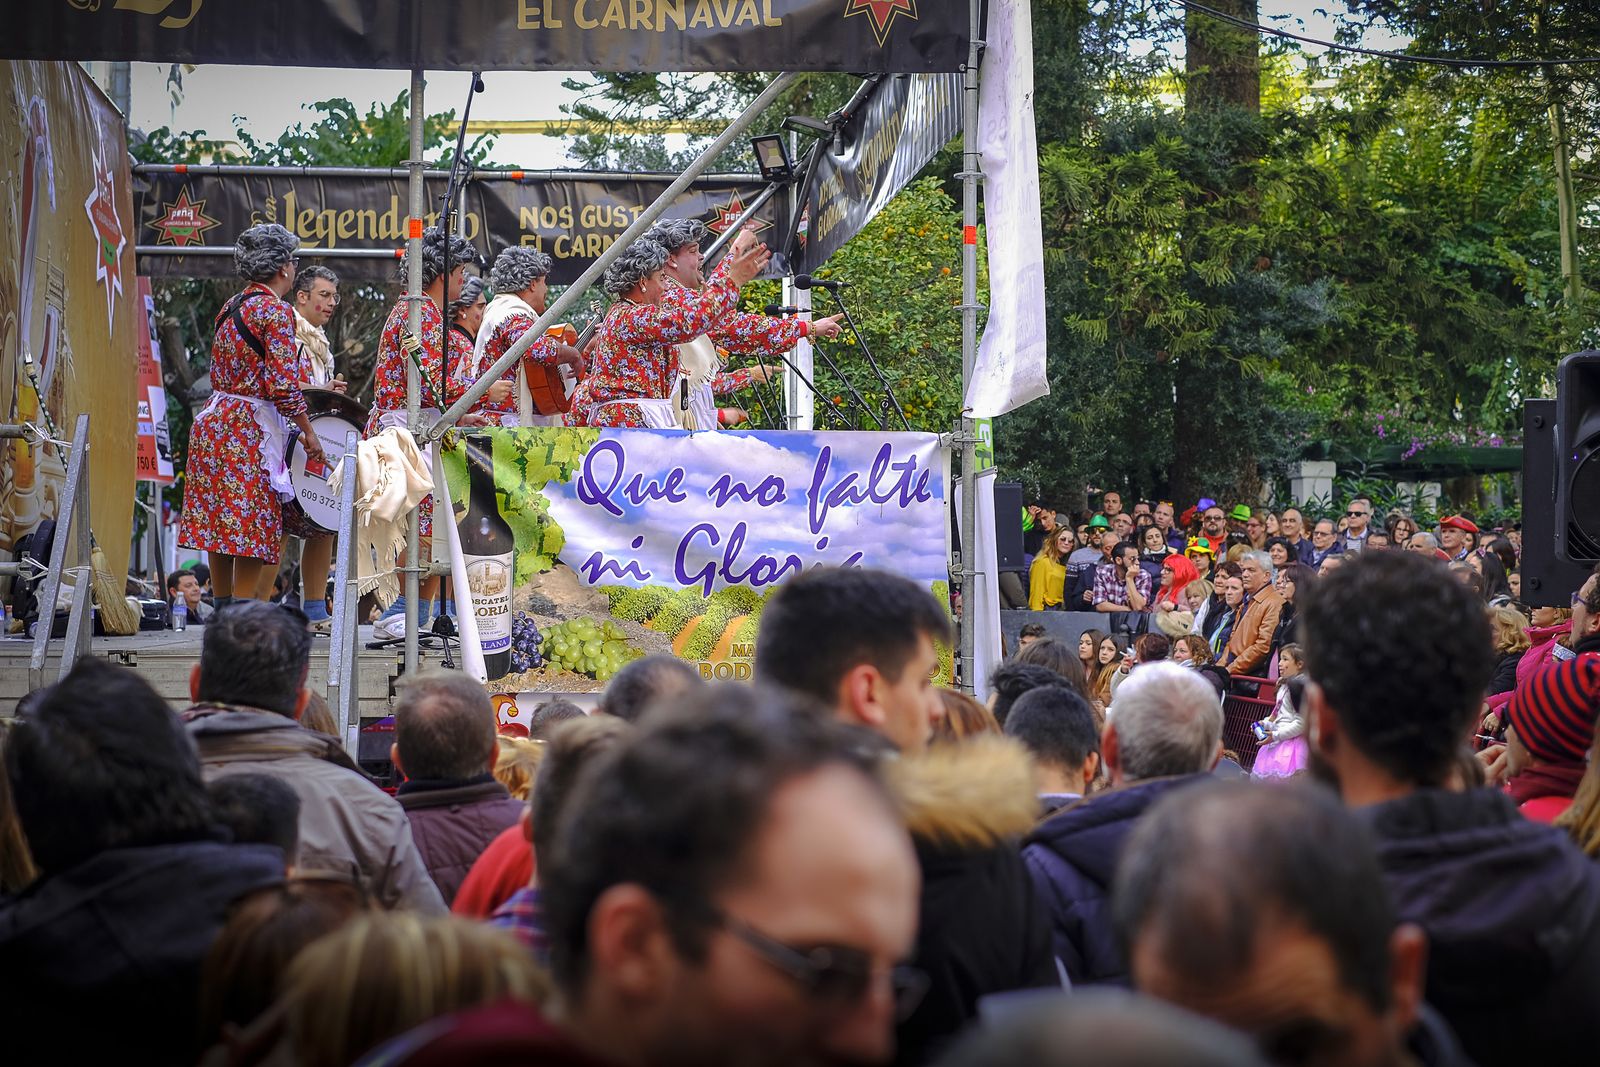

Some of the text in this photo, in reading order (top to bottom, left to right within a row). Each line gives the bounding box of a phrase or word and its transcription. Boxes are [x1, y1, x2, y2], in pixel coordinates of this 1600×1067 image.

[517, 0, 783, 32] EL CARNAVAL
[519, 204, 656, 230] NOS GUST
[553, 233, 621, 259] CARN
[577, 439, 687, 516] Que
[708, 474, 787, 508] no
[807, 443, 931, 535] falte
[301, 488, 318, 502] 609
[319, 495, 336, 509] 372
[472, 595, 509, 605] SCATEL
[474, 604, 509, 616] ORIA
[481, 640, 507, 649] LANA
[730, 643, 756, 658] MA
[697, 662, 755, 681] BOD
